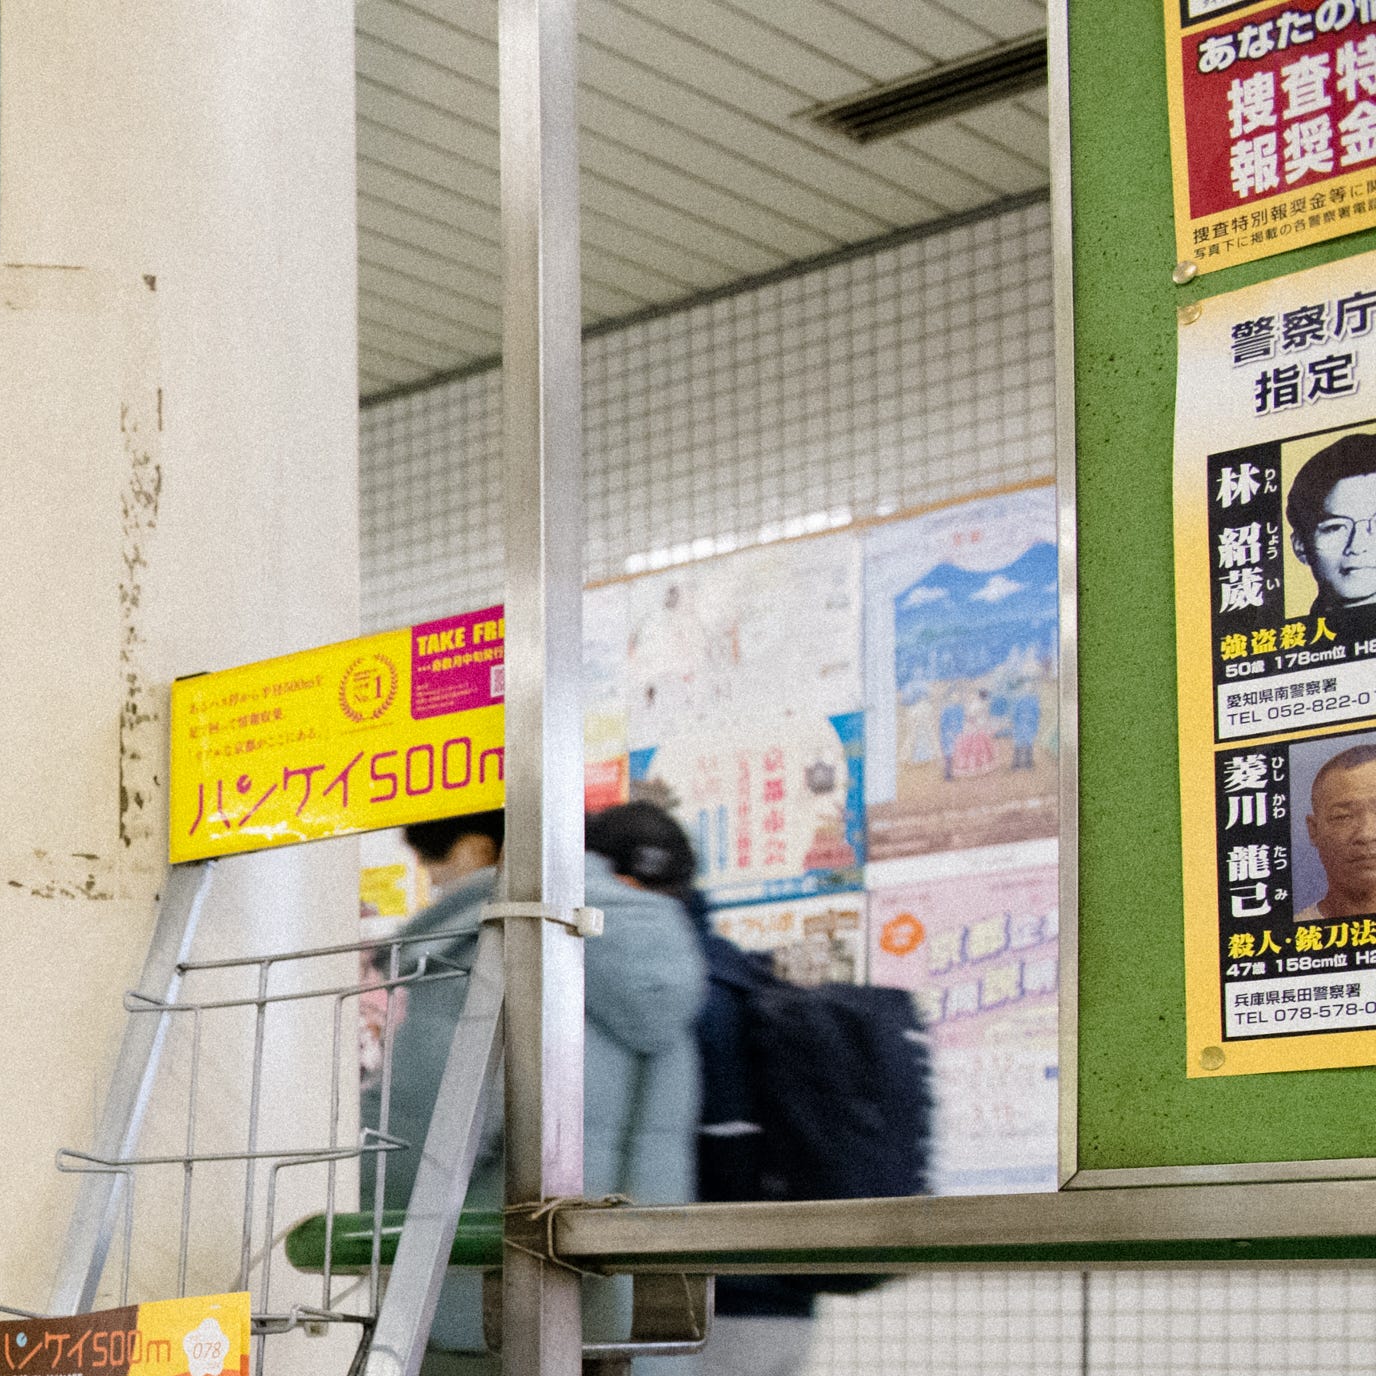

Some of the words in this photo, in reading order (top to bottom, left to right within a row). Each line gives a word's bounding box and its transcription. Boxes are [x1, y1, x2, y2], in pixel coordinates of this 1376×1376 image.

[1227, 34, 1376, 138] 捜査特
[1230, 101, 1376, 199] 報奨金
[1231, 291, 1376, 365] 警察庁
[1255, 353, 1355, 413] 指定
[416, 626, 466, 657] TAKE
[1221, 617, 1338, 662] 強盗殺人
[1227, 677, 1337, 710] 愛知県南警察署
[1227, 711, 1262, 727] TEL
[1267, 691, 1376, 721] 052-822-0
[1234, 981, 1361, 1007] 兵庫県長田警察署
[1234, 1010, 1268, 1026] TEL
[192, 1341, 222, 1361] 078
